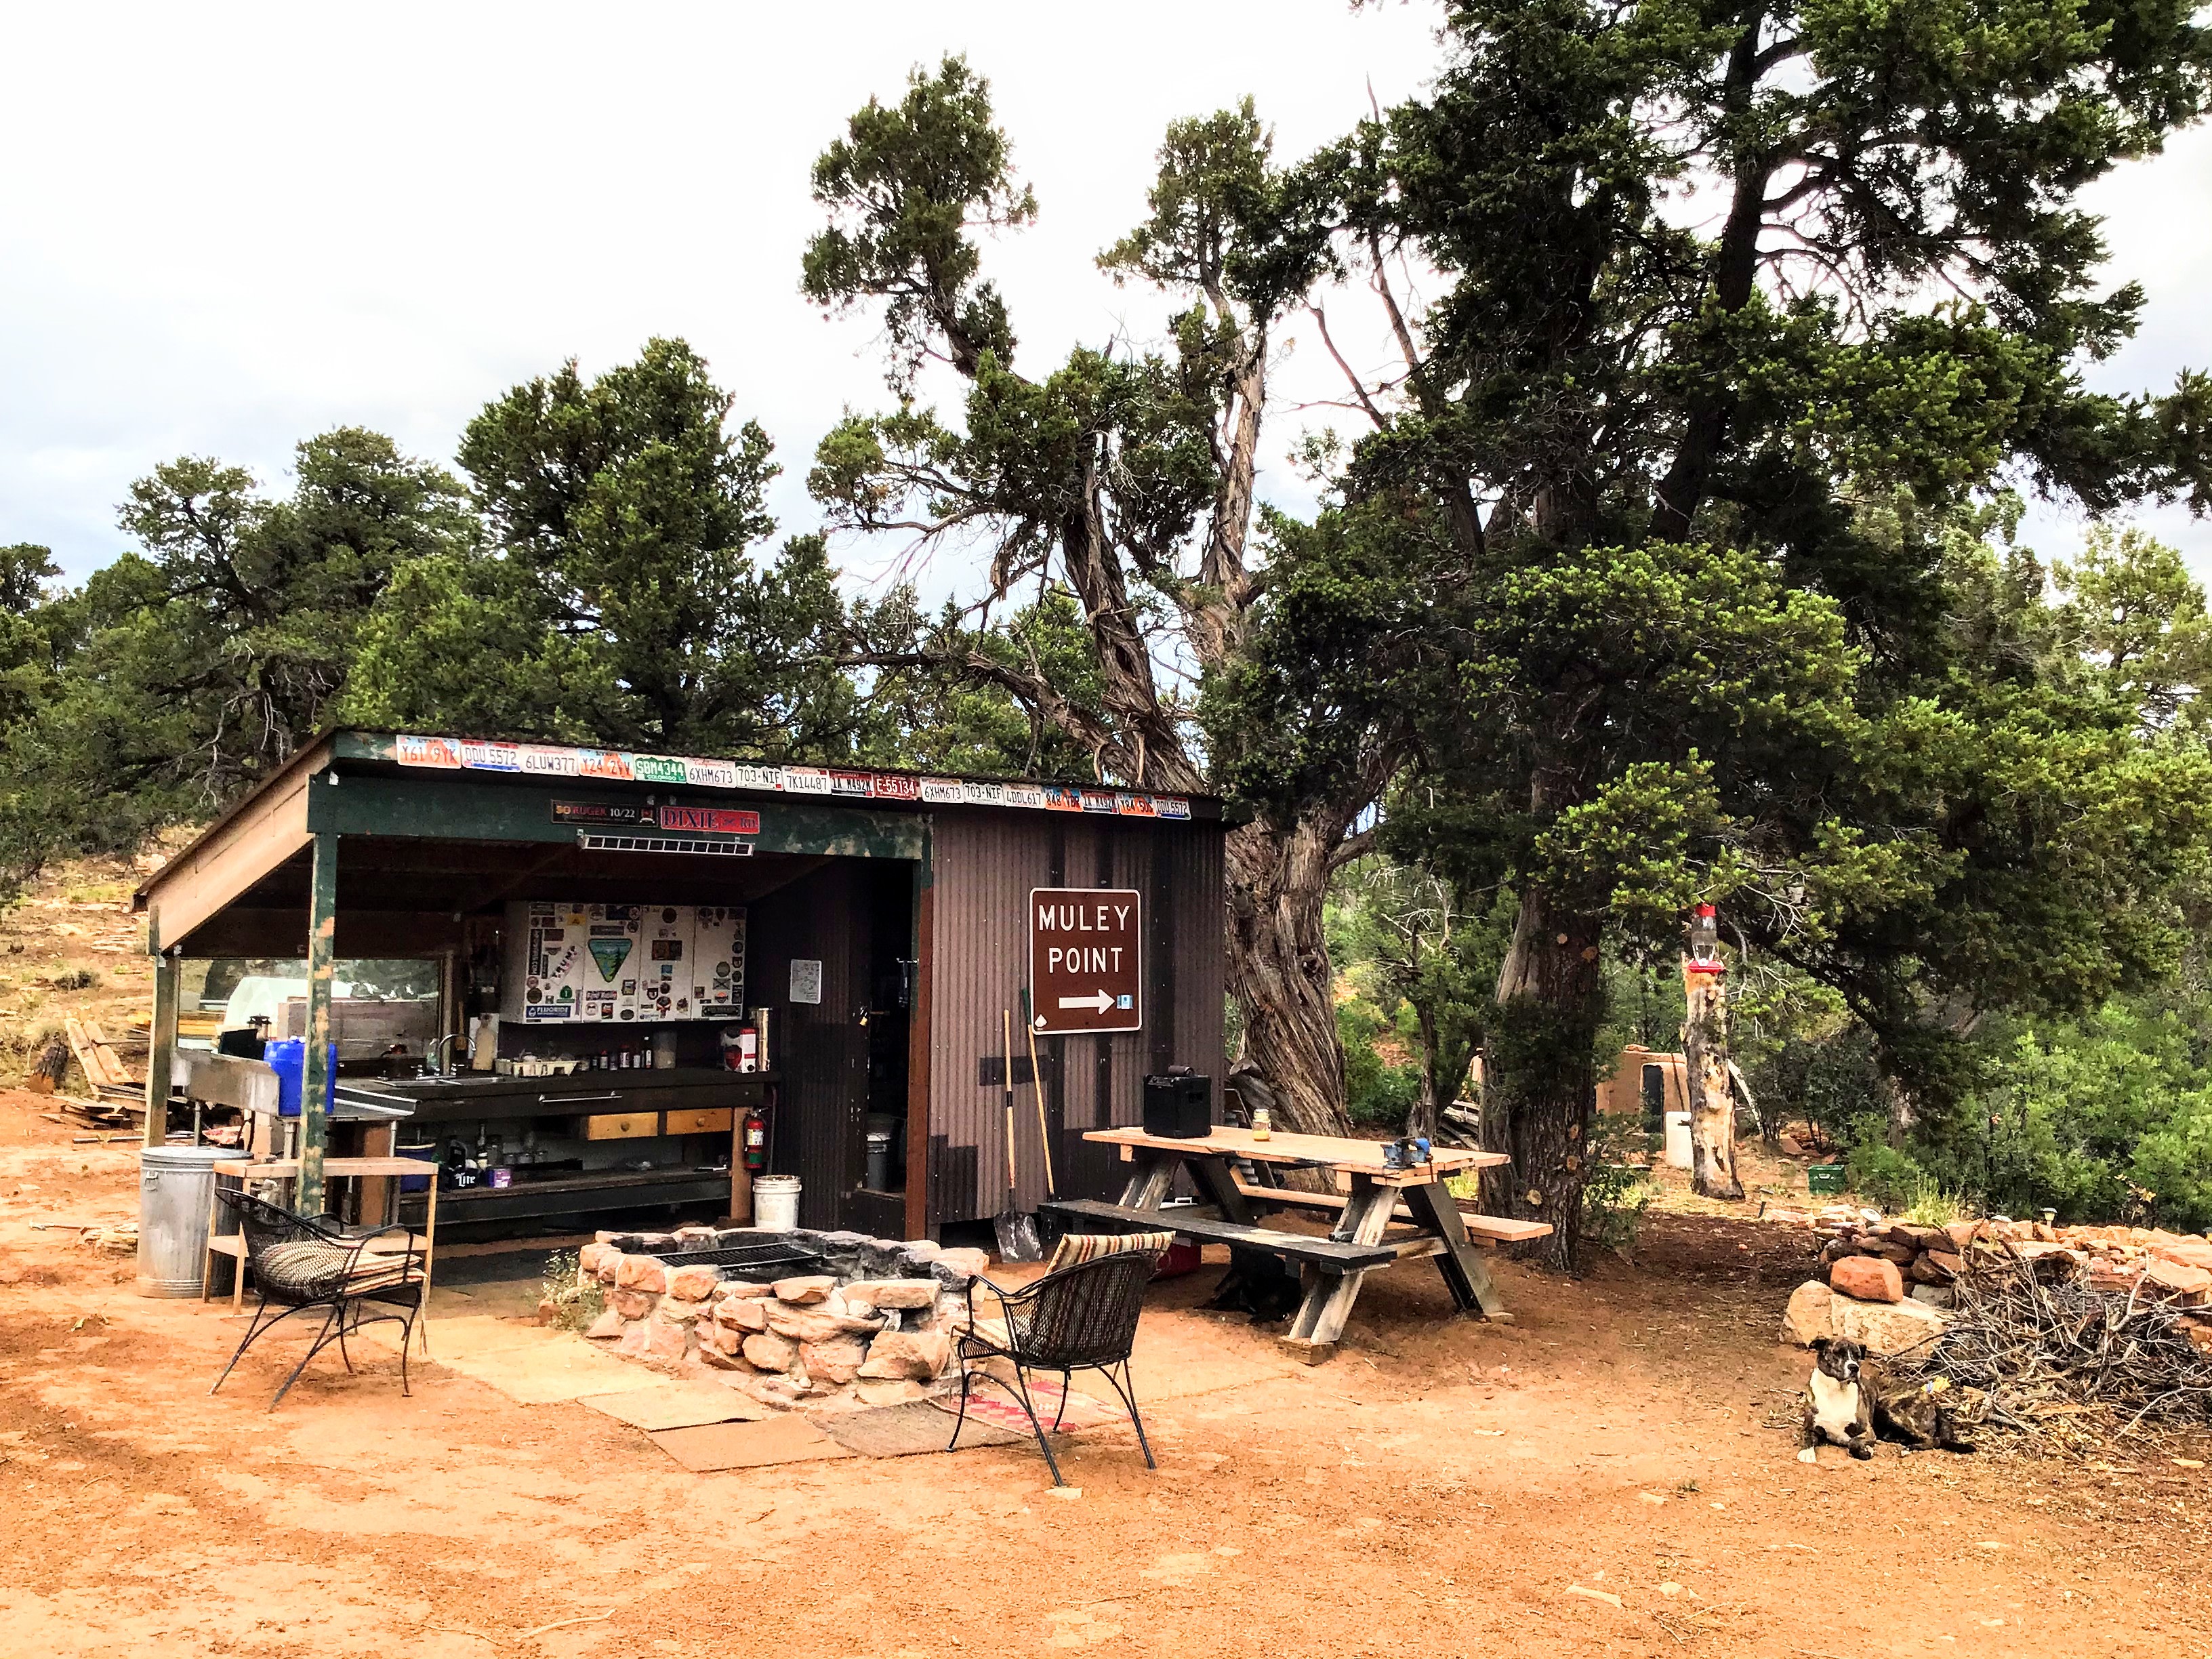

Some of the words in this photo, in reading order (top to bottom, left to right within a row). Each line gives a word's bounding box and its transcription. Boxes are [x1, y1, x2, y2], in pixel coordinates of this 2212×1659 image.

[489, 749, 518, 766] 5572
[689, 767, 733, 783] 6XHM673
[876, 779, 916, 795] E-55134
[924, 785, 962, 800] 6XHM673
[1006, 790, 1042, 805] 4DDL617
[609, 807, 636, 819] 10/22
[663, 808, 719, 829] DIXIE
[1039, 905, 1130, 931] MULEY
[1049, 947, 1123, 974] POINT
[453, 1172, 476, 1187] Lite
